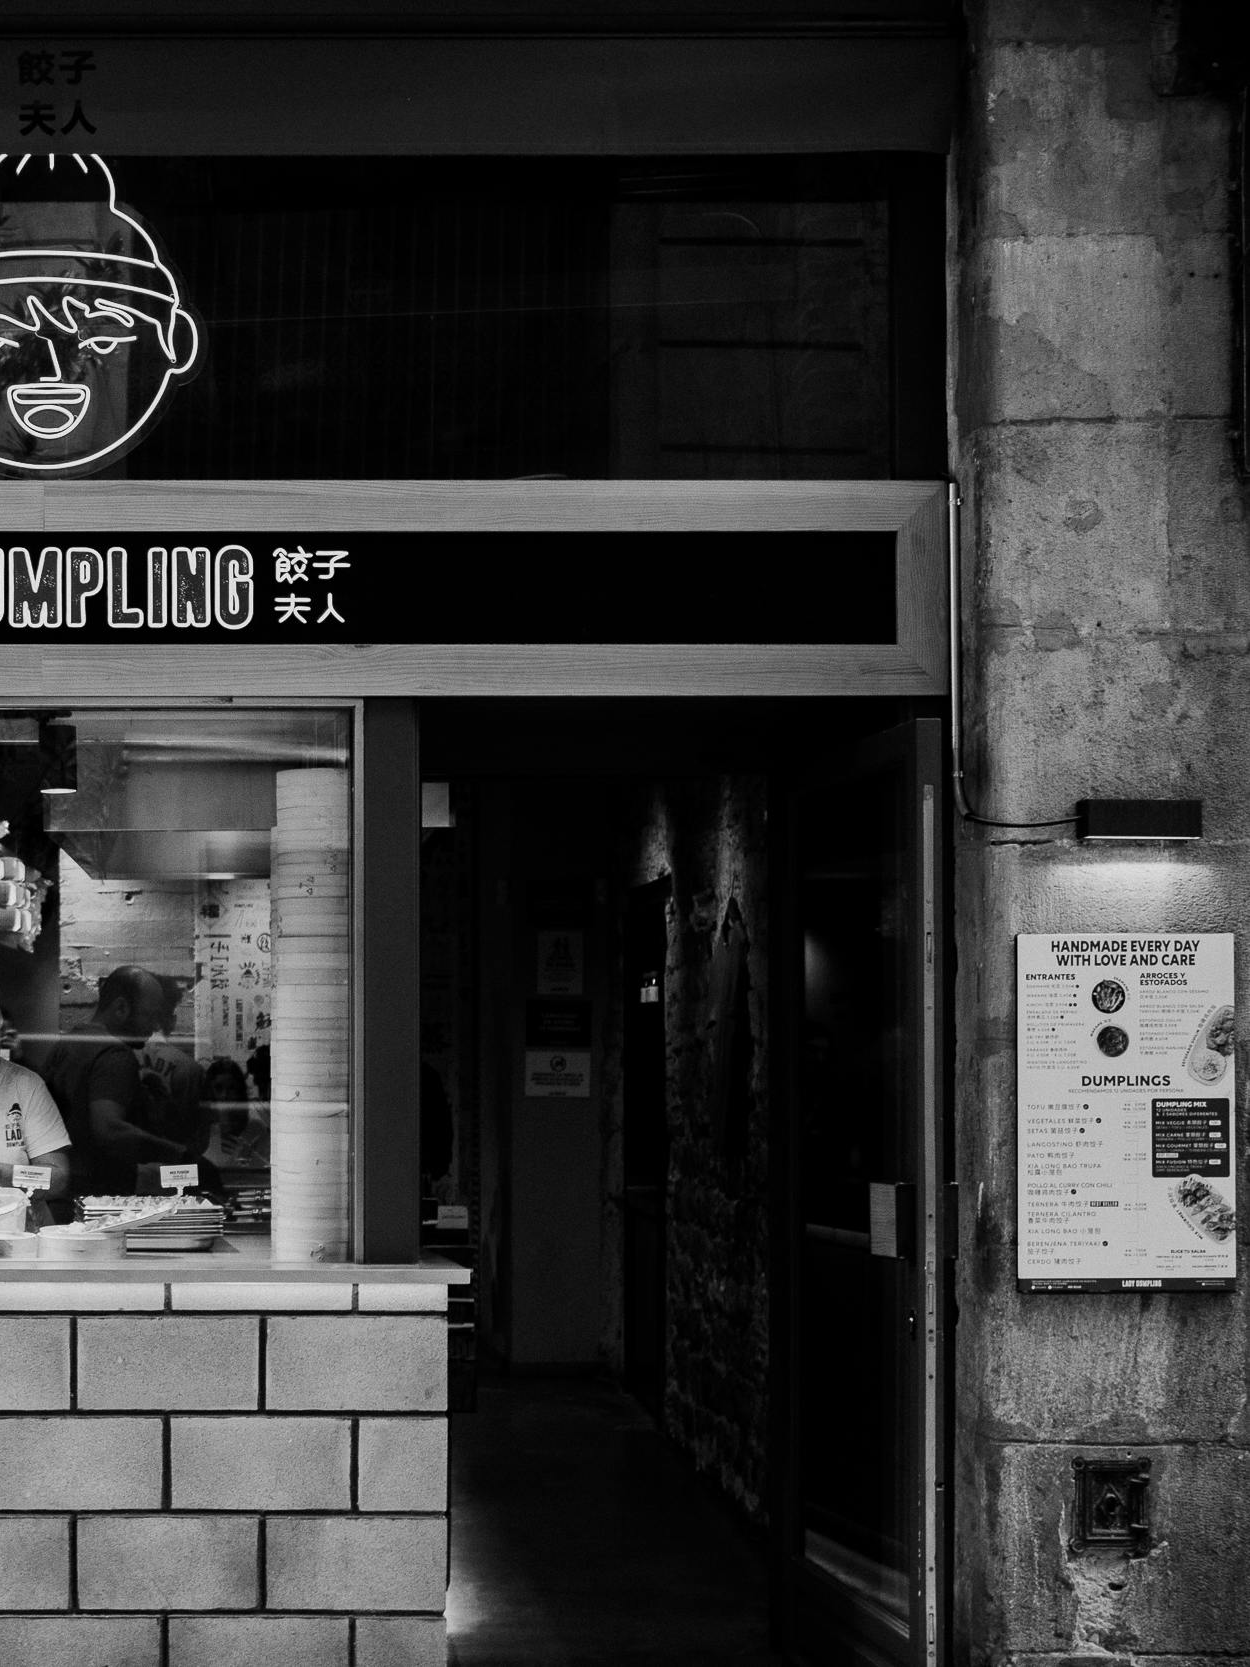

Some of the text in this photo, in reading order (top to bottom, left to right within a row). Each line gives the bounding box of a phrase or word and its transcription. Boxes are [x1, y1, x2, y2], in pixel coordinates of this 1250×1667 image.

[18, 99, 98, 137] 夫人
[272, 546, 351, 584] 餃子
[273, 591, 347, 625] 夫人
[1051, 940, 1200, 953] HANDMADE EVERY DAY
[1056, 953, 1196, 966] WITH LOVE AND CARE
[1025, 973, 1076, 981] ENTRANTES
[1081, 1075, 1171, 1087] DUMPLINGS
[5, 1128, 23, 1141] LAD
